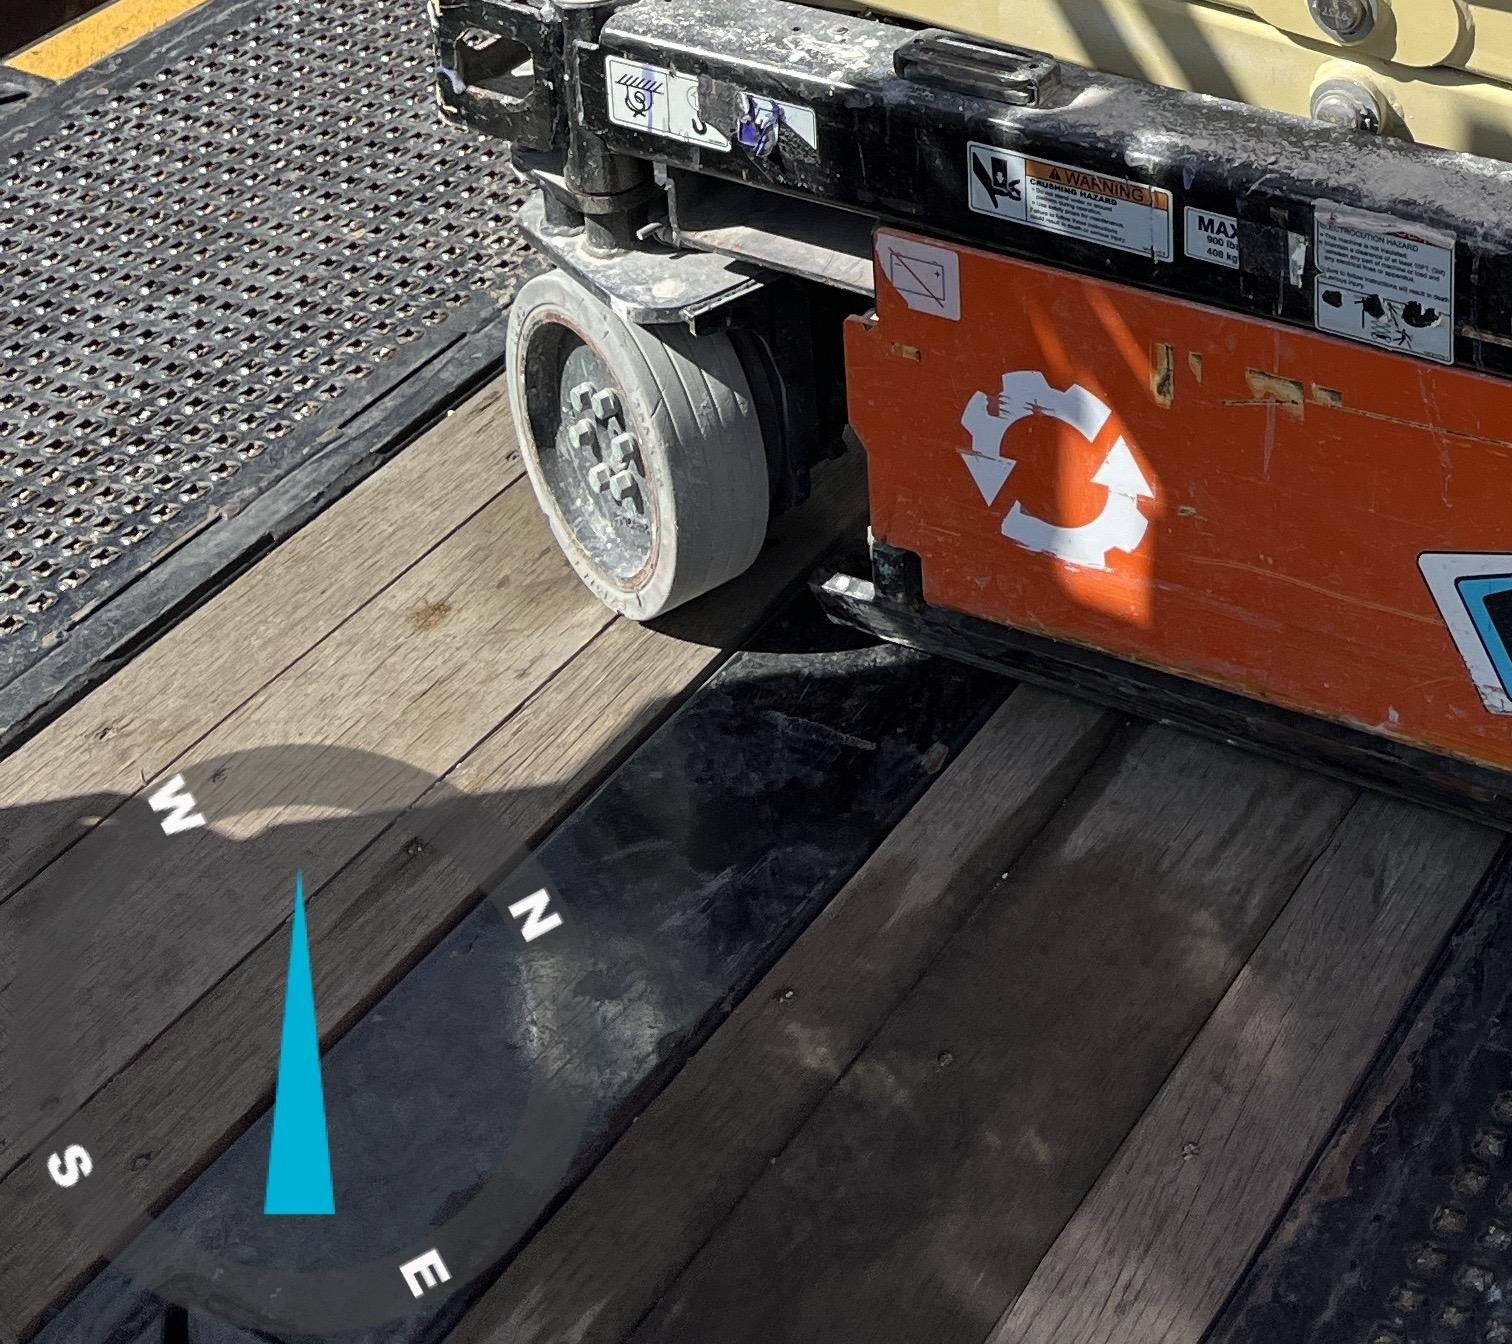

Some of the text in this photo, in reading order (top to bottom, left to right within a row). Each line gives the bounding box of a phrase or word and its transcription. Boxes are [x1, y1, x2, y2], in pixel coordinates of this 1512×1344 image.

[1029, 178, 1118, 207] CRUSHING HAZARD
[1064, 170, 1145, 203] WARNING
[1206, 234, 1224, 248] 900
[1386, 237, 1419, 253] HAZARD
[1206, 247, 1239, 265] 408 kg
